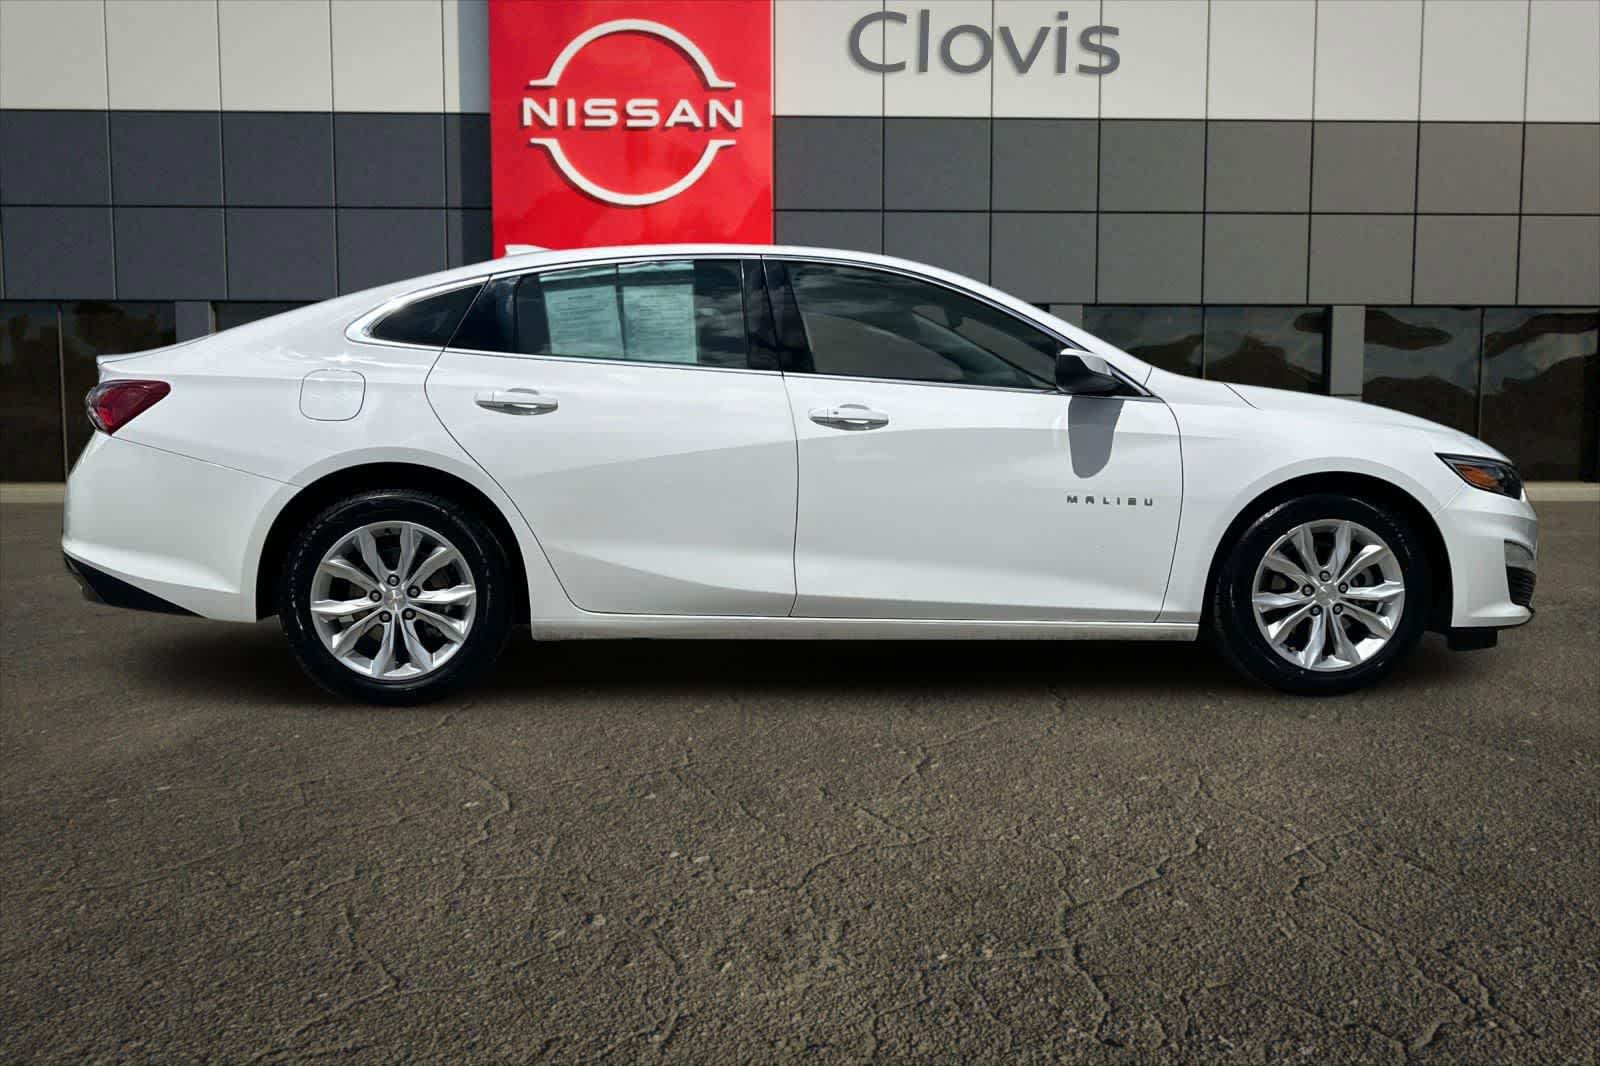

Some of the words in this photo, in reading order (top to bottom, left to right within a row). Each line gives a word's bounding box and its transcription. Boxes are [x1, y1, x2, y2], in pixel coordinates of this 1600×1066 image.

[848, 9, 1121, 75] Clovis
[522, 97, 744, 129] NISSAN
[1066, 495, 1153, 507] MALIBU
